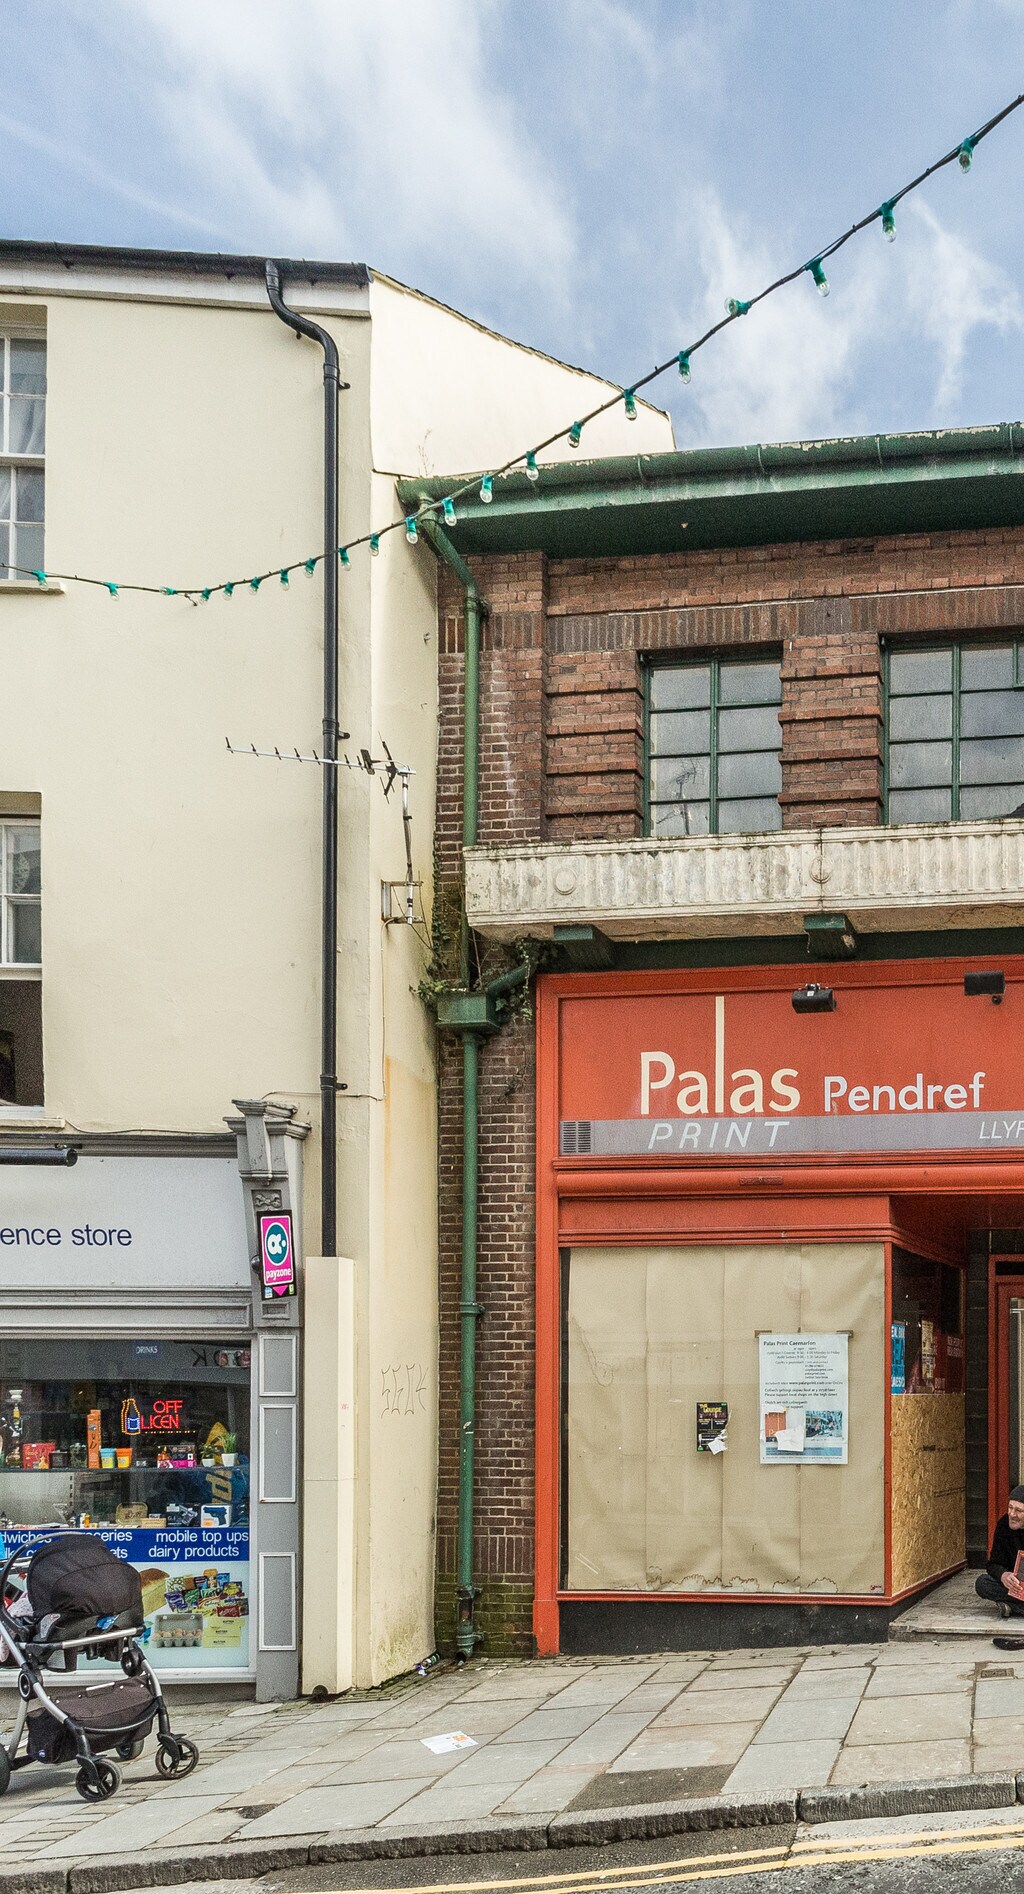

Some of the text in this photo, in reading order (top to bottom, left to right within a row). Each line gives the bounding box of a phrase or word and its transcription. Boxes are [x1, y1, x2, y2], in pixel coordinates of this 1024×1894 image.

[640, 996, 986, 1115] Palas Pendref
[648, 1121, 790, 1149] PRINT
[71, 1224, 132, 1246] store
[266, 1268, 291, 1281] payzone
[136, 1346, 158, 1354] DRINKS
[153, 1400, 183, 1413] OFF
[141, 1415, 179, 1429] LICEN
[156, 1530, 249, 1546] mobile top ups
[149, 1545, 240, 1560] dairy products
